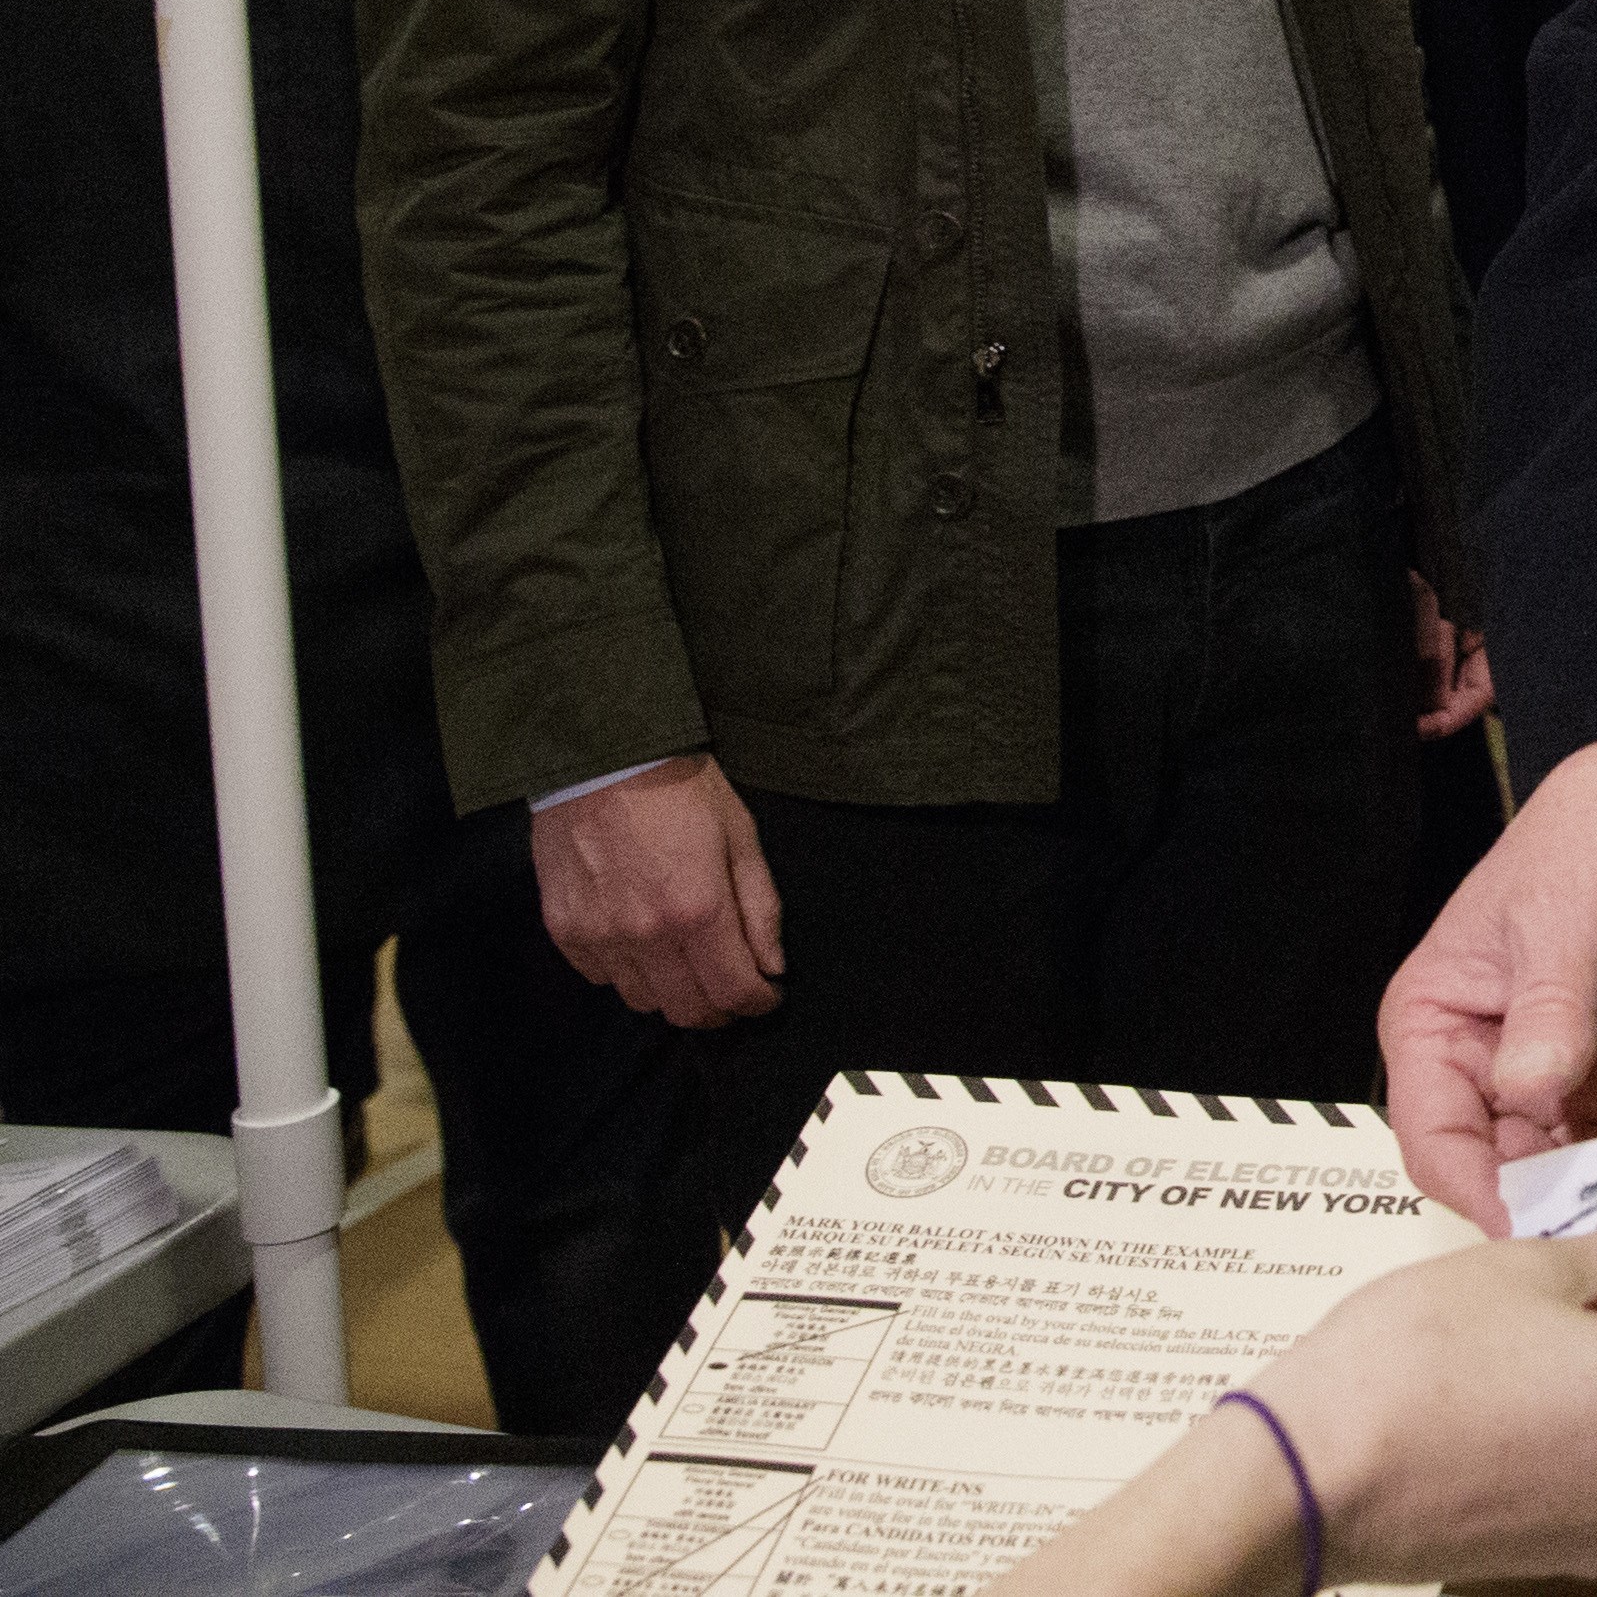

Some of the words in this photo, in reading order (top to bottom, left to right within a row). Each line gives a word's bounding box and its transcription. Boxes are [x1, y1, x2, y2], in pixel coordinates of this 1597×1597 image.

[981, 1145, 1114, 1174] BOARD
[1125, 1157, 1178, 1178] OF
[1184, 1160, 1400, 1189] ELECTIONS
[966, 1174, 994, 1191] IN
[1001, 1176, 1053, 1197] THE
[1062, 1178, 1156, 1203] CITY
[1160, 1184, 1212, 1207] OF
[1220, 1188, 1311, 1211] NEW
[1322, 1193, 1426, 1215] YORK
[778, 1228, 864, 1244] MARQUE
[866, 1235, 893, 1246] SU
[896, 1237, 993, 1255] PAPELETA
[1068, 1251, 1092, 1263] SE
[1096, 1253, 1187, 1271] MUESTRA
[1193, 1260, 1221, 1272] EN
[1223, 1261, 1247, 1274] EL
[1253, 1262, 1344, 1278] EJEMPLO
[785, 1215, 846, 1230] MARK
[851, 1220, 904, 1234] YOUR
[907, 1224, 987, 1241] BALLOT
[989, 1232, 1015, 1243] AS
[1017, 1233, 1091, 1249] SHOWN
[1094, 1239, 1115, 1251] IN
[1121, 1241, 1159, 1255] THE
[1162, 1244, 1255, 1261] EXAMPLE
[761, 1258, 799, 1274] 아래
[885, 1267, 939, 1284] 귀하의
[1042, 1281, 1081, 1297] 표기
[1088, 1284, 1158, 1303] 하십시오
[904, 1319, 946, 1334] Llene
[949, 1325, 964, 1335] el
[1011, 1333, 1049, 1344] cerca
[1053, 1334, 1072, 1346] de
[1074, 1339, 1092, 1347] su
[1166, 1343, 1238, 1355] utilizando
[1241, 1345, 1255, 1356] la
[910, 1305, 938, 1318] Fill
[941, 1310, 955, 1319] in
[959, 1310, 982, 1322] the
[985, 1314, 1019, 1325] oval
[1020, 1315, 1040, 1330] by
[1042, 1320, 1077, 1331] your
[1080, 1322, 1127, 1335] choice
[1131, 1328, 1170, 1341] using
[1174, 1328, 1197, 1339] the
[1200, 1328, 1259, 1341] BLACK
[1262, 1333, 1290, 1344] pen
[896, 1334, 915, 1346] de
[918, 1337, 951, 1350] tinta
[817, 1485, 846, 1500] Fill
[849, 1491, 864, 1502] in
[868, 1491, 892, 1505] the
[895, 1497, 931, 1509] oval
[934, 1498, 956, 1511] for
[824, 1468, 870, 1486] FOR
[876, 1474, 984, 1496] WRITE-INS
[800, 1518, 840, 1534] Para
[845, 1523, 974, 1545] CANDIDATOS
[978, 1534, 1019, 1548] POR
[808, 1505, 833, 1516] are
[838, 1508, 887, 1525] voting
[891, 1511, 913, 1524] for
[937, 1515, 961, 1528] the
[965, 1520, 1007, 1533] space
[784, 1555, 846, 1569] votando
[850, 1561, 869, 1572] en
[891, 1566, 950, 1579] espacio
[881, 1547, 911, 1560] por
